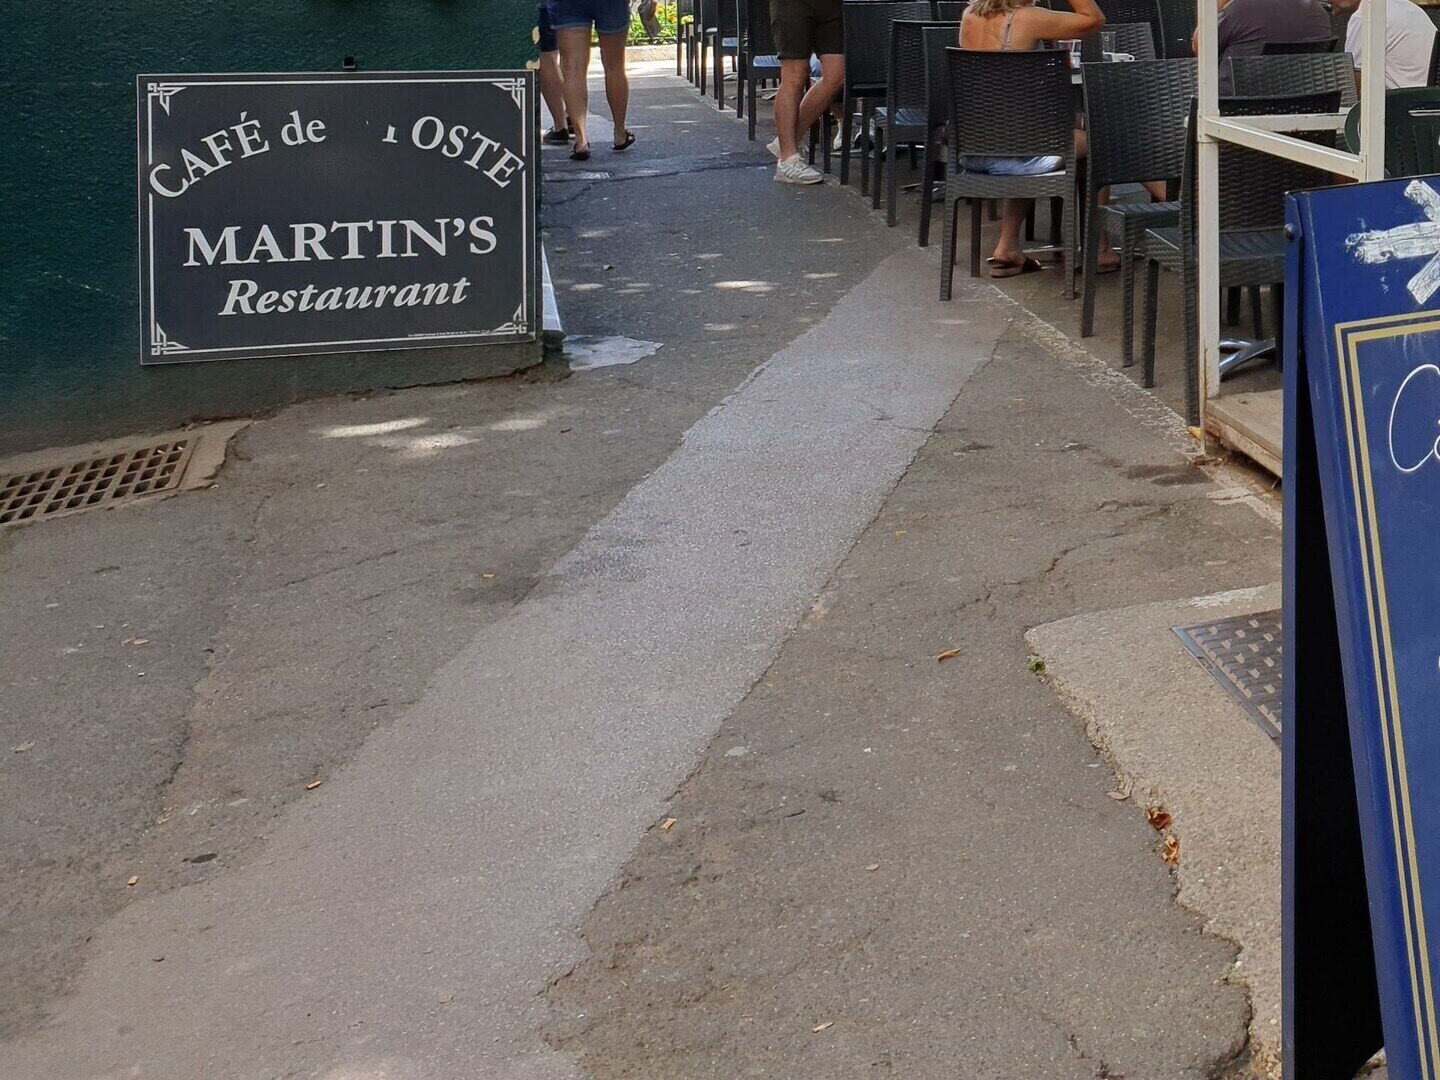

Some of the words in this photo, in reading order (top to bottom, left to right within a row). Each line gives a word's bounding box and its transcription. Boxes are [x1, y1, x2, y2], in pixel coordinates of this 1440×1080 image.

[150, 111, 270, 199] CAFÉ
[280, 110, 327, 146] de
[382, 115, 525, 188] OSTE
[182, 215, 498, 267] MARTIN'S
[217, 276, 471, 317] Restaurant
